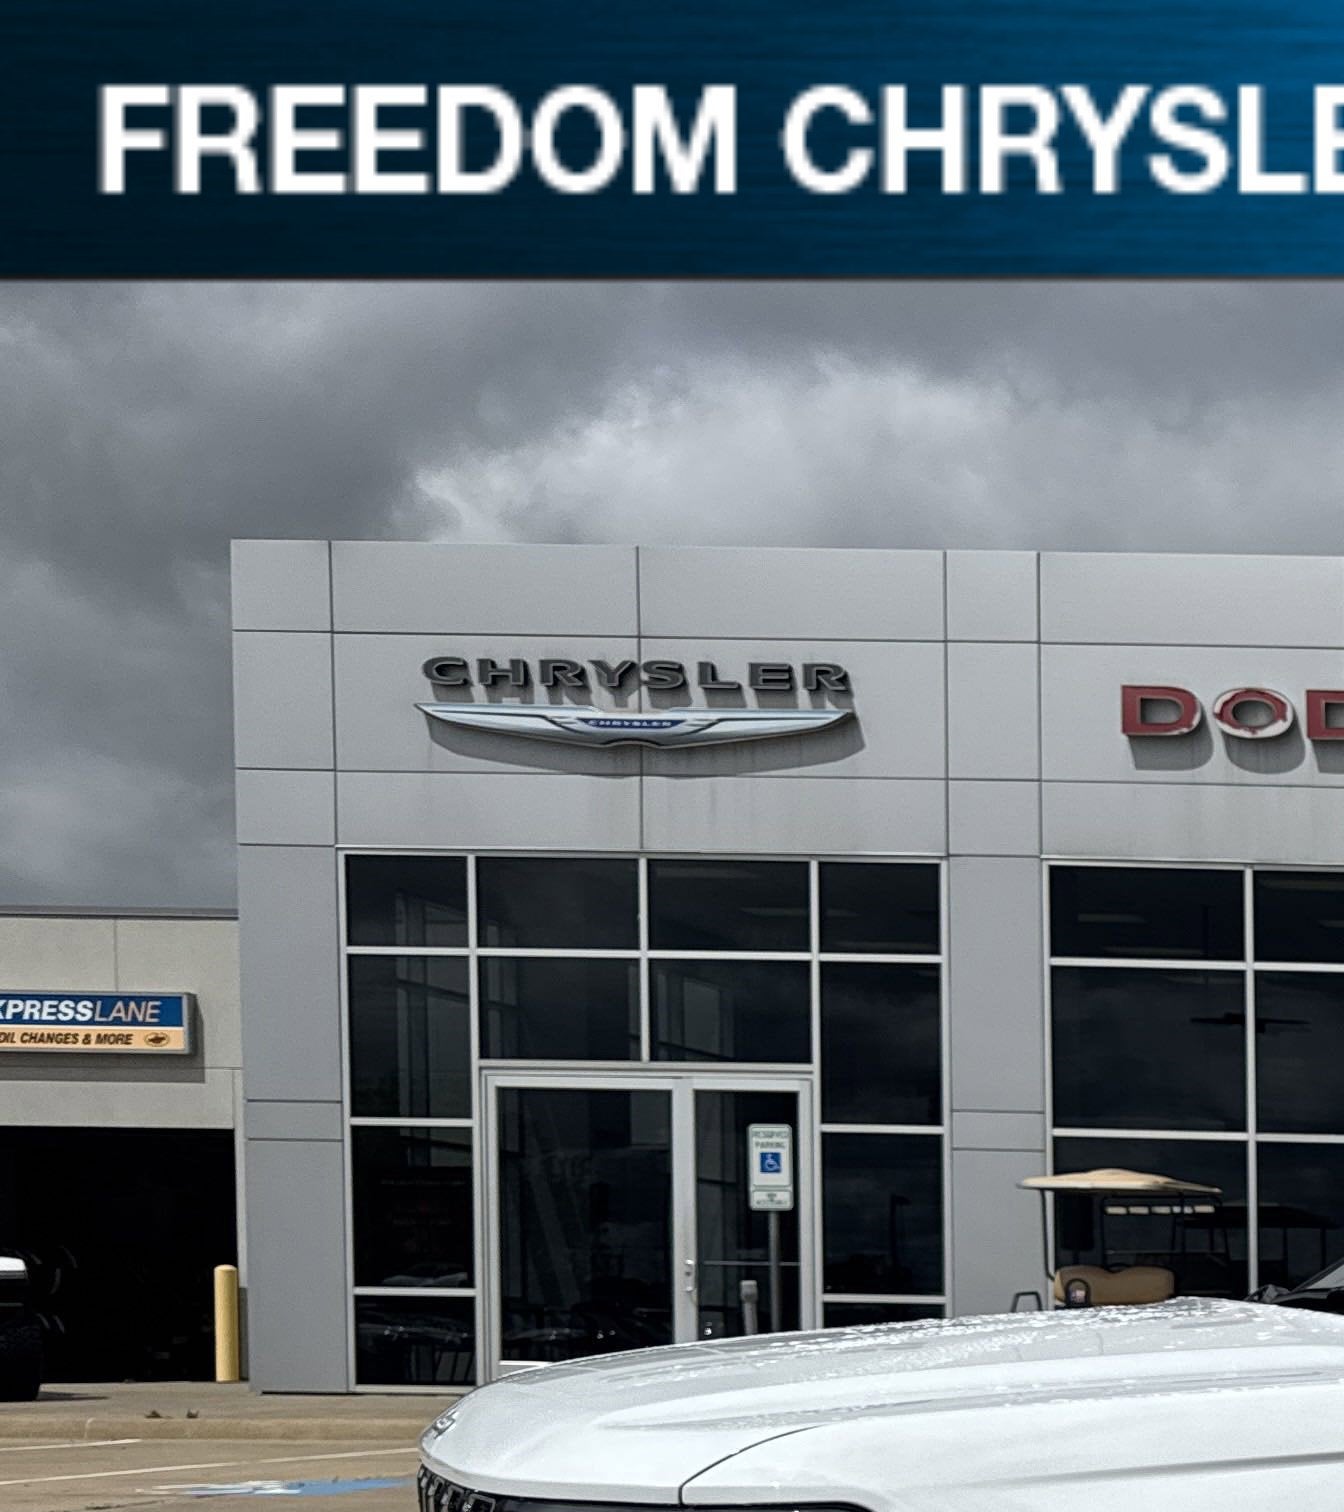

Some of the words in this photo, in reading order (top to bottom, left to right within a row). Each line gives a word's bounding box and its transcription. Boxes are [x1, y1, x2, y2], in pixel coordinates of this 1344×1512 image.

[422, 656, 850, 691] CHRYSLER
[20, 1031, 80, 1045] CHANGES
[81, 1033, 92, 1045] &
[95, 1033, 134, 1045] MORE
